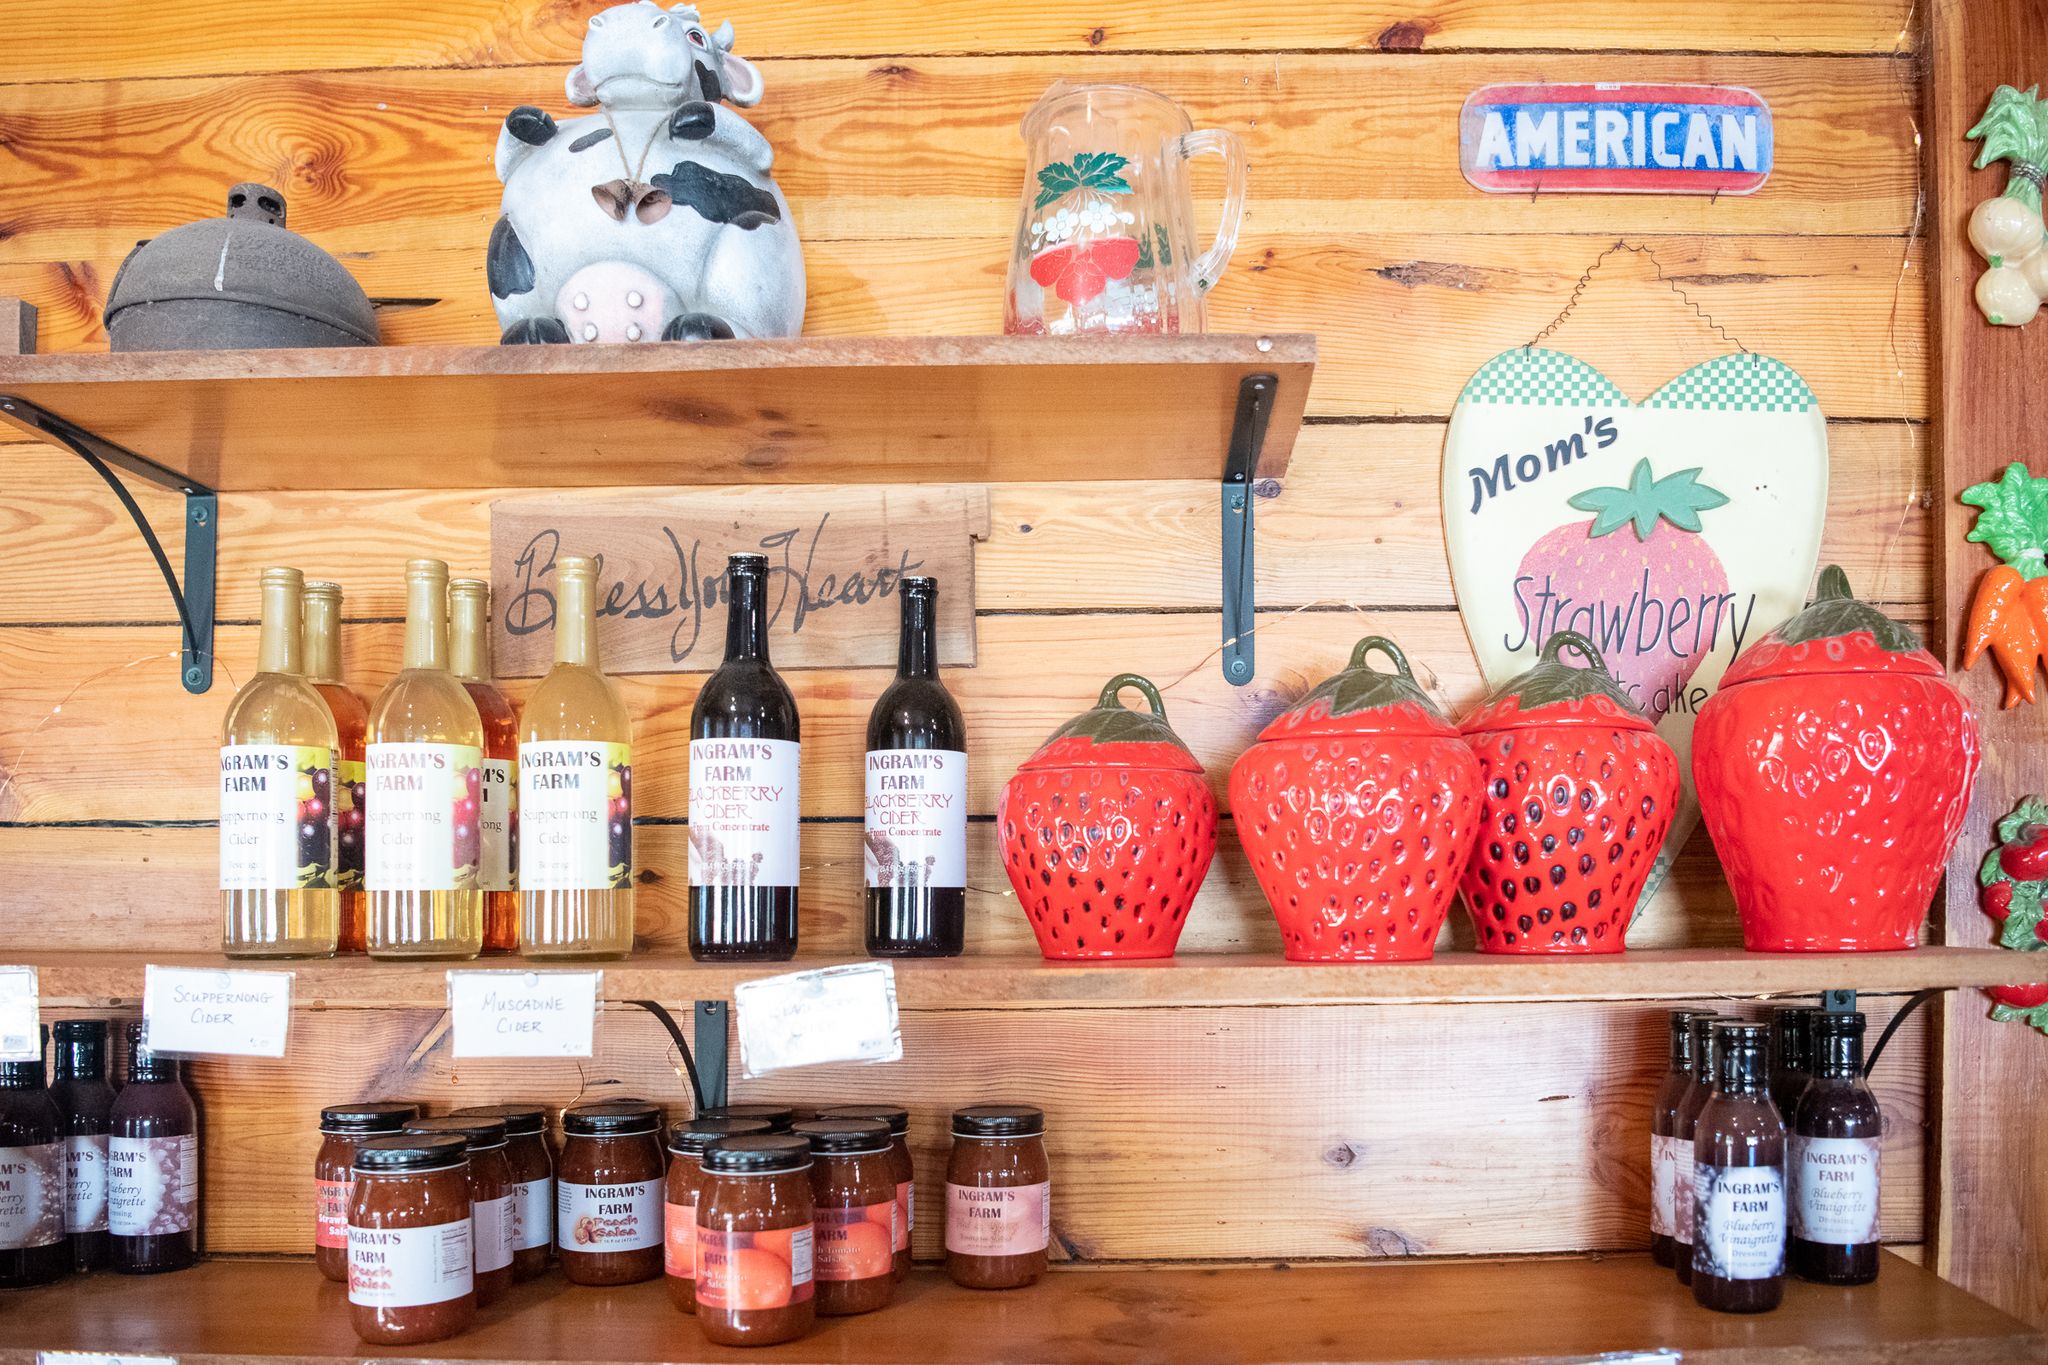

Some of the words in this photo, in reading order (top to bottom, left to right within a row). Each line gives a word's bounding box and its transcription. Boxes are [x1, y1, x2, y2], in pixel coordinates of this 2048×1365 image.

[1475, 110, 1757, 170] AMERICAN
[1467, 415, 1618, 515] Mom's
[504, 528, 678, 636] Bess
[759, 512, 926, 635] Heart
[1503, 568, 1756, 667] Strawberry
[693, 743, 773, 761] INGRAM'S
[221, 754, 289, 771] GRAM'S
[367, 752, 445, 770] NGRAM'S
[521, 751, 601, 769] INGRAM'S
[869, 754, 944, 771] INGRAM'S
[704, 766, 752, 781] FARM
[225, 776, 266, 793] FARM
[376, 775, 423, 791] FARM
[533, 773, 580, 790] FARM
[880, 775, 925, 790] FARM
[689, 786, 784, 808] LACKBERRY
[704, 804, 753, 819] CIDER
[880, 811, 927, 825] CIDER
[228, 832, 259, 845] Cider
[539, 832, 571, 845] Cide
[869, 828, 886, 837] From
[190, 1008, 234, 1025] CIDER
[496, 1017, 545, 1034] CIDER
[1806, 1151, 1868, 1165] INGRAM'S
[1819, 1170, 1855, 1182] FARM
[585, 1185, 645, 1199] INGRAM'S
[958, 1189, 1015, 1202] INGRAM'S
[1718, 1182, 1780, 1194] INGRAM'S
[1811, 1187, 1864, 1203] Blueberry
[599, 1203, 632, 1215] FARM
[969, 1207, 1001, 1218] FARM
[1732, 1201, 1768, 1212] FARM
[319, 1214, 348, 1225] Strawb
[593, 1215, 639, 1226] Peach
[1723, 1219, 1776, 1233] Blueberry
[328, 1226, 348, 1235] Sals
[349, 1230, 402, 1245] NGRAM'S
[1719, 1232, 1779, 1248] Vnaigrette
[355, 1250, 385, 1263] FARM
